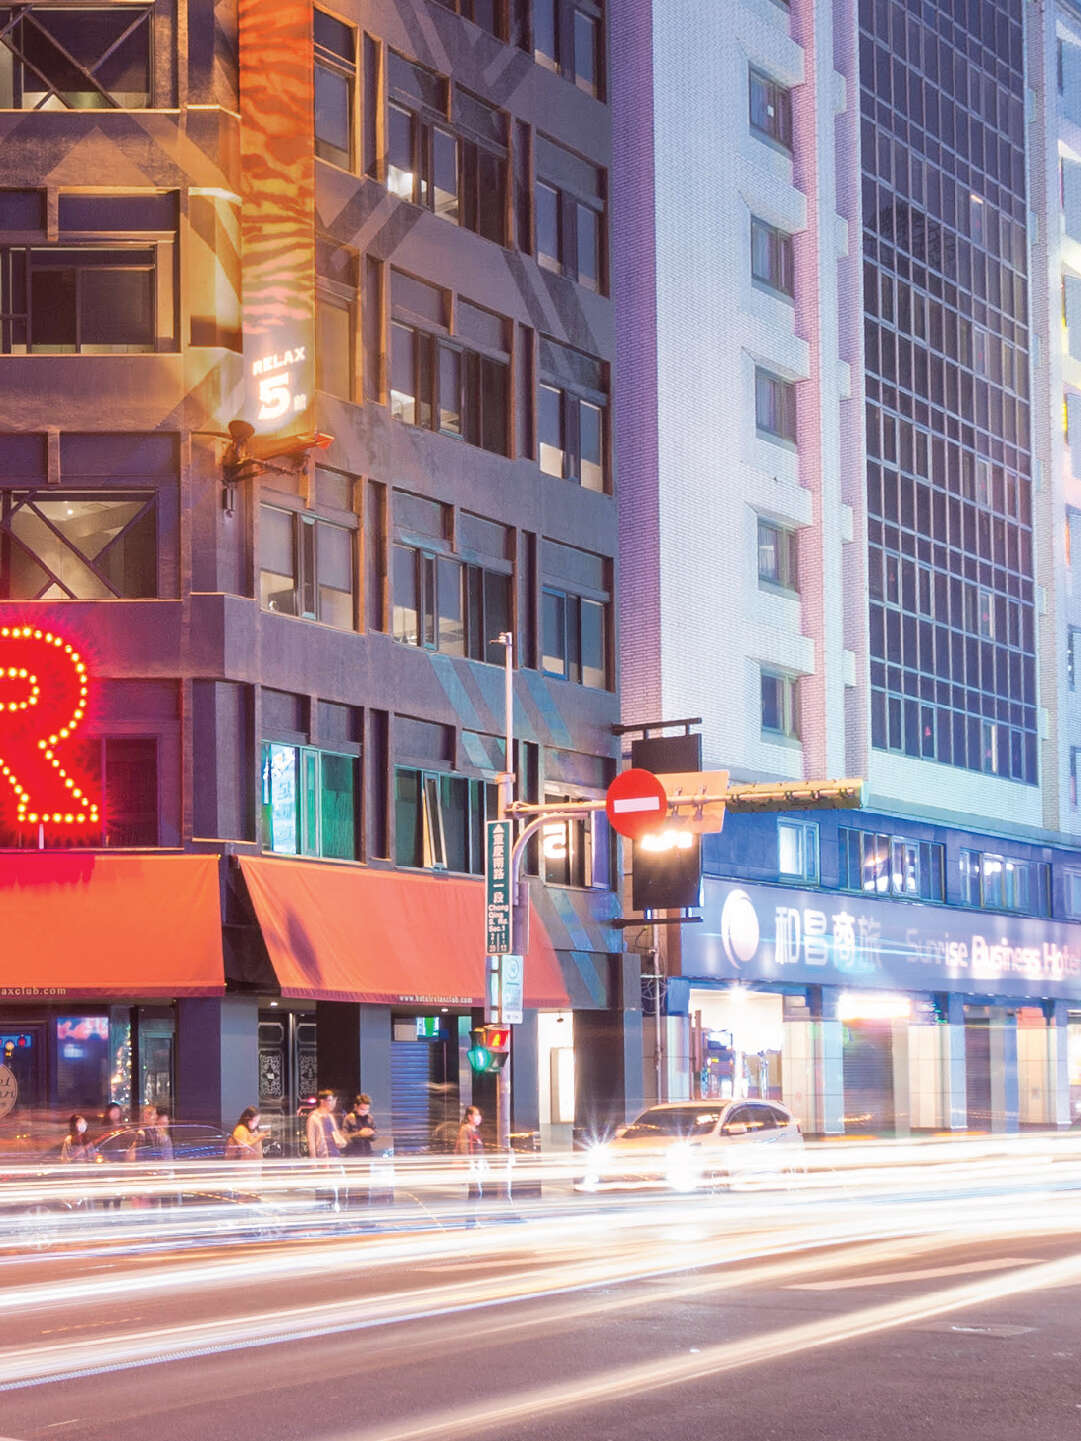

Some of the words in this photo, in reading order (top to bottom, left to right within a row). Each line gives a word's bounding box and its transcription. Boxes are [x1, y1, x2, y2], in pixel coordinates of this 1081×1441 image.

[252, 345, 306, 376] RELAX
[257, 371, 290, 421] 5
[775, 906, 882, 969] 和昌商旅
[905, 928, 969, 968] Sunrise
[971, 934, 1041, 973] Business
[1042, 942, 1081, 976] Hote
